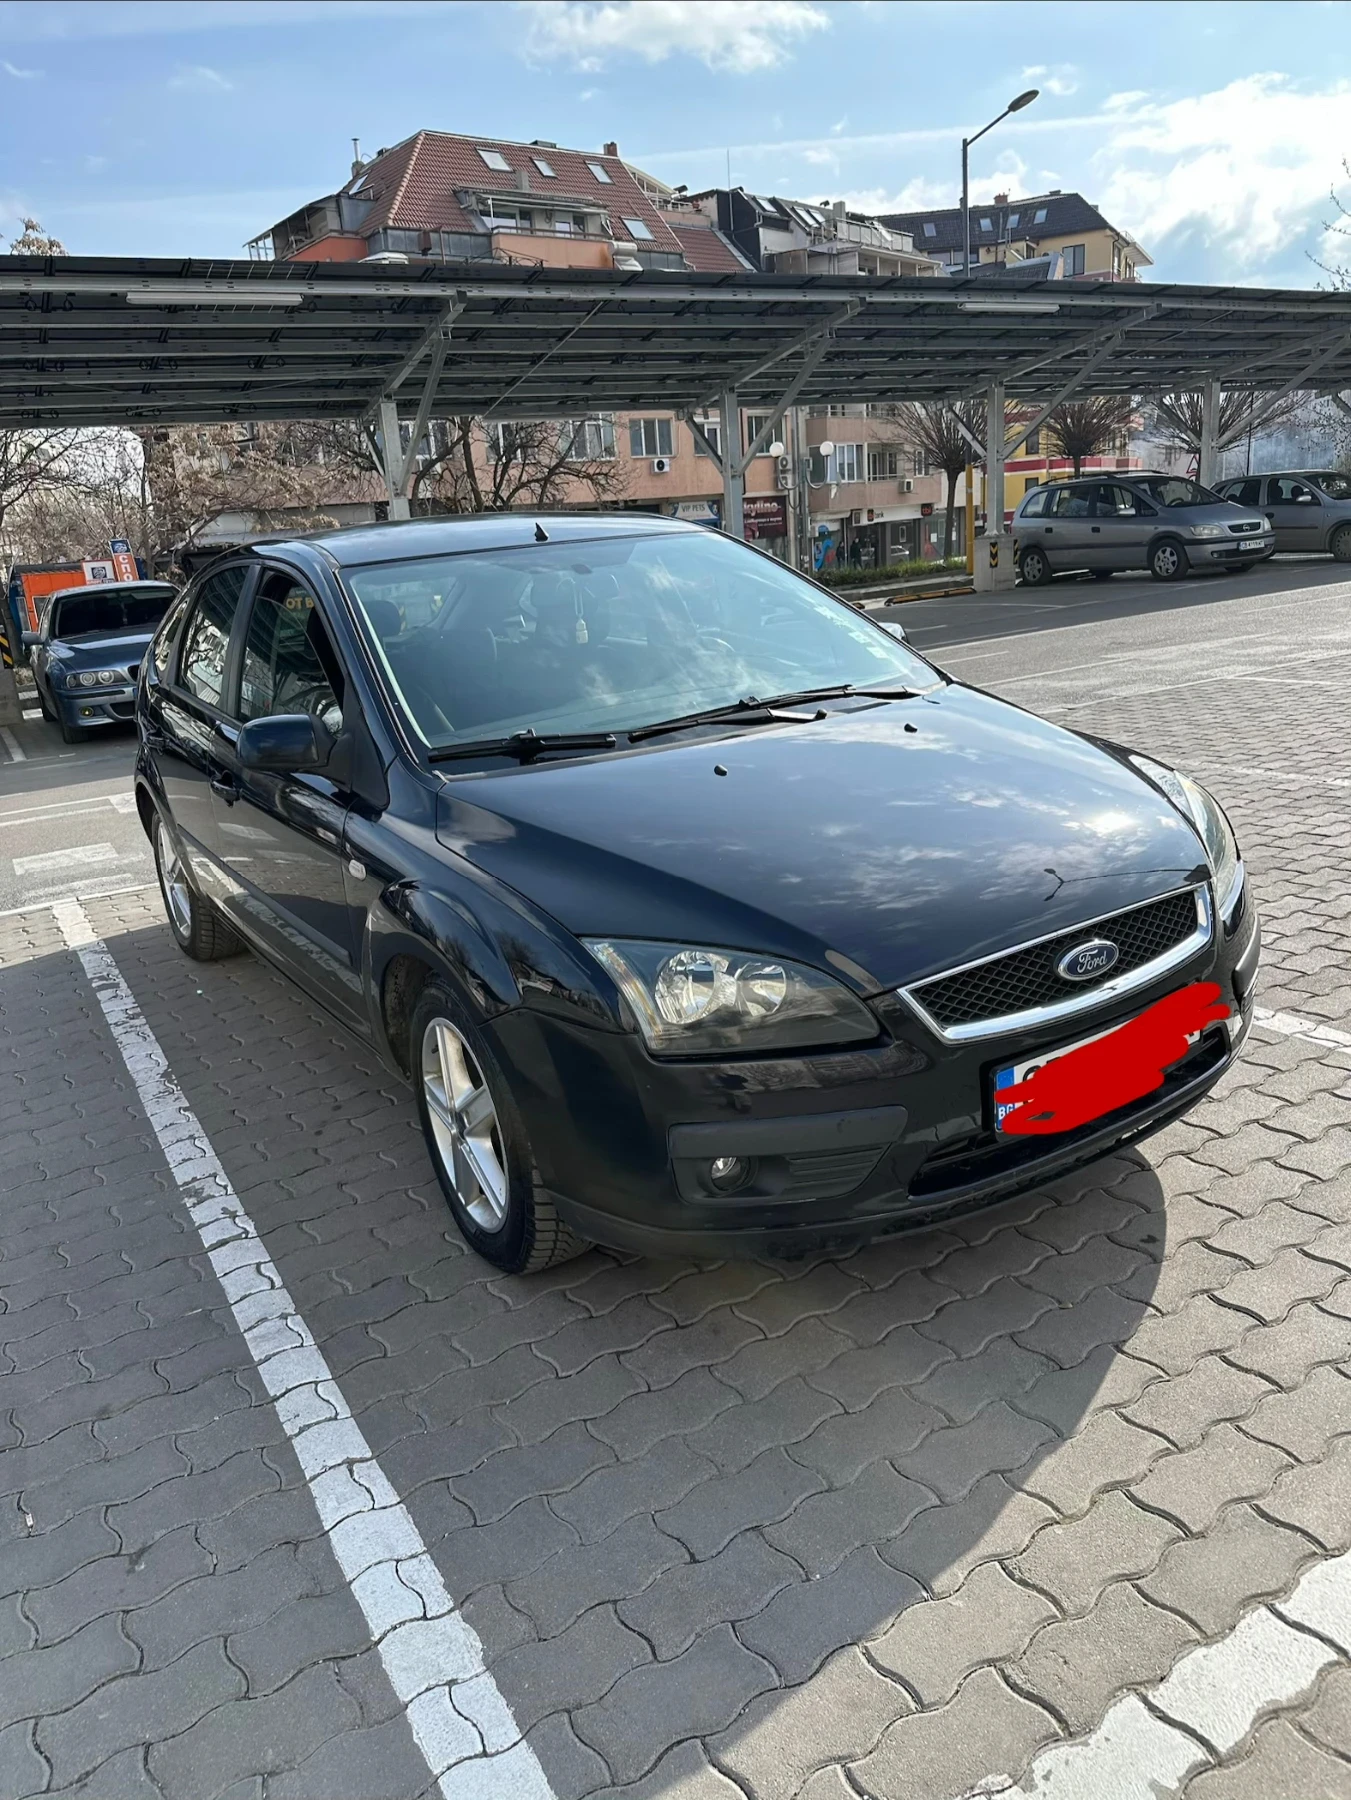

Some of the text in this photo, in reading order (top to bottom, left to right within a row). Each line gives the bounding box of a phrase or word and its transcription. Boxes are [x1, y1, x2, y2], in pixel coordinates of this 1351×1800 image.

[681, 503, 706, 513] VIP PETS
[743, 501, 776, 517] kyline
[119, 555, 133, 581] СПО
[1077, 949, 1107, 973] Ford
[998, 1103, 1014, 1120] BG
